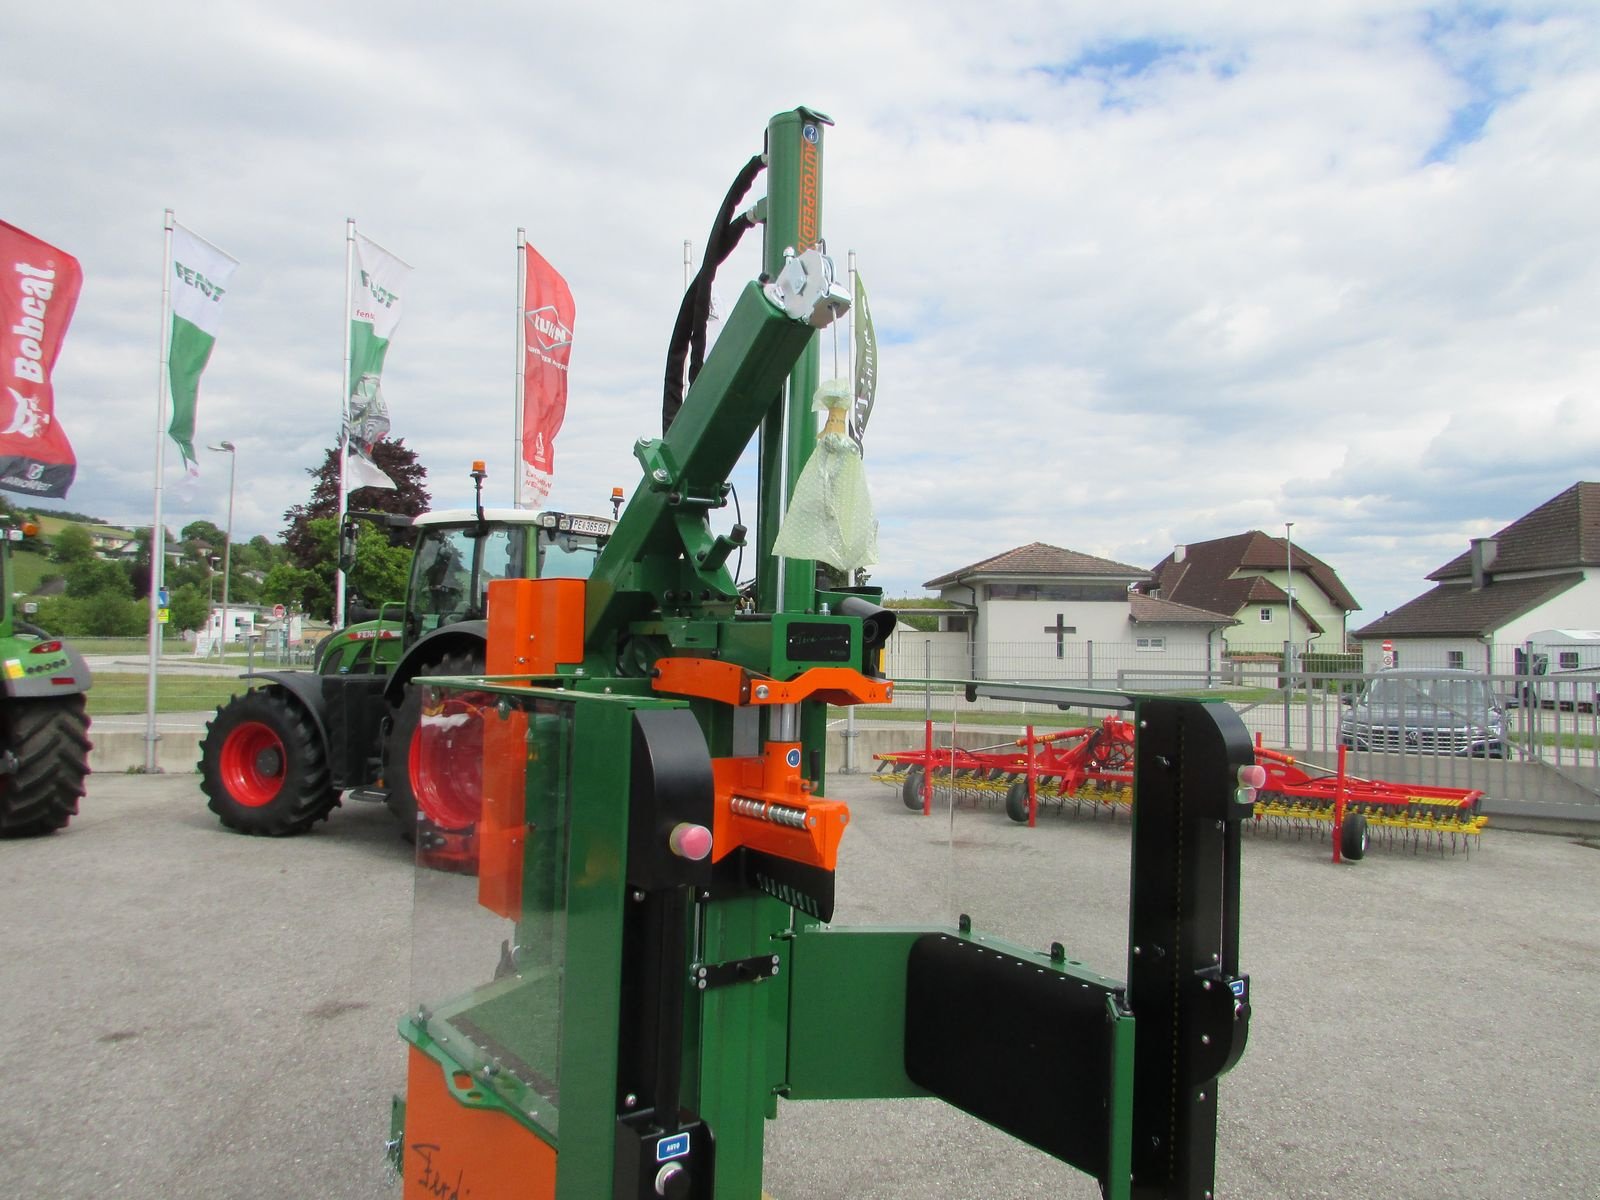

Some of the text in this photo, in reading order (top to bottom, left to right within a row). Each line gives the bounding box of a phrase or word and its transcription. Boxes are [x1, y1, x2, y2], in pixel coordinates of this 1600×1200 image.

[803, 142, 817, 239] AUTOSPEED
[175, 260, 226, 302] FENDT
[12, 262, 56, 384] Bobcat
[666, 1142, 681, 1152] AUTO
